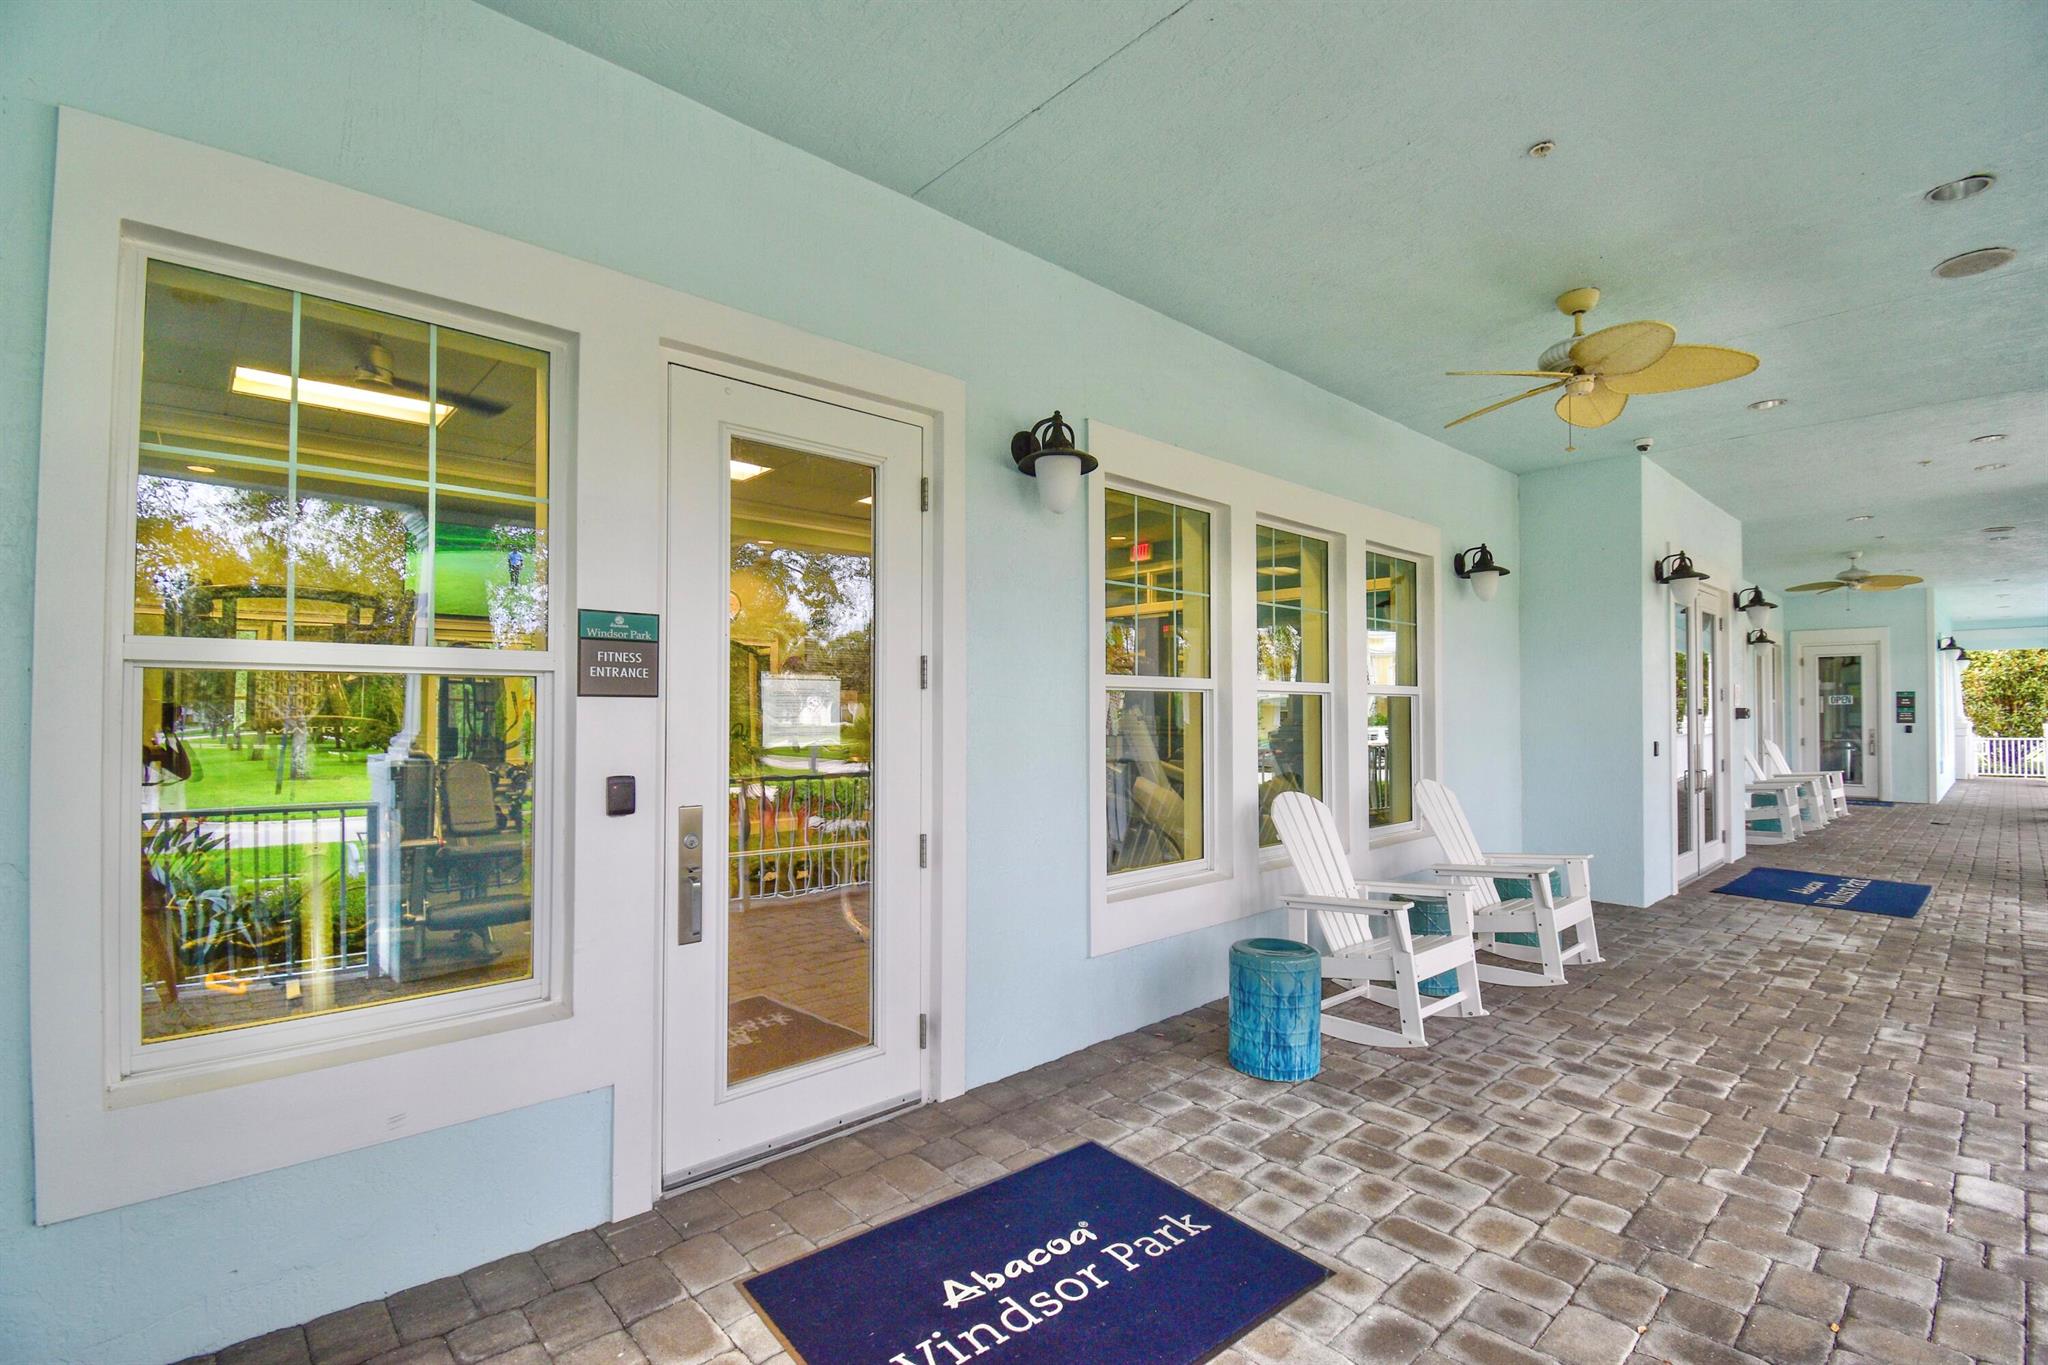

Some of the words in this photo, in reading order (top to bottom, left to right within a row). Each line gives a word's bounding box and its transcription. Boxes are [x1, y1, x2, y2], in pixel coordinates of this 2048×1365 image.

[586, 627, 628, 639] Windsor
[630, 630, 652, 640] Park
[597, 651, 642, 663] FITNESS
[590, 666, 649, 679] ENTRANCE
[1829, 696, 1852, 704] OPEN
[271, 726, 359, 734] MATRIX
[1101, 1214, 1212, 1272] Park
